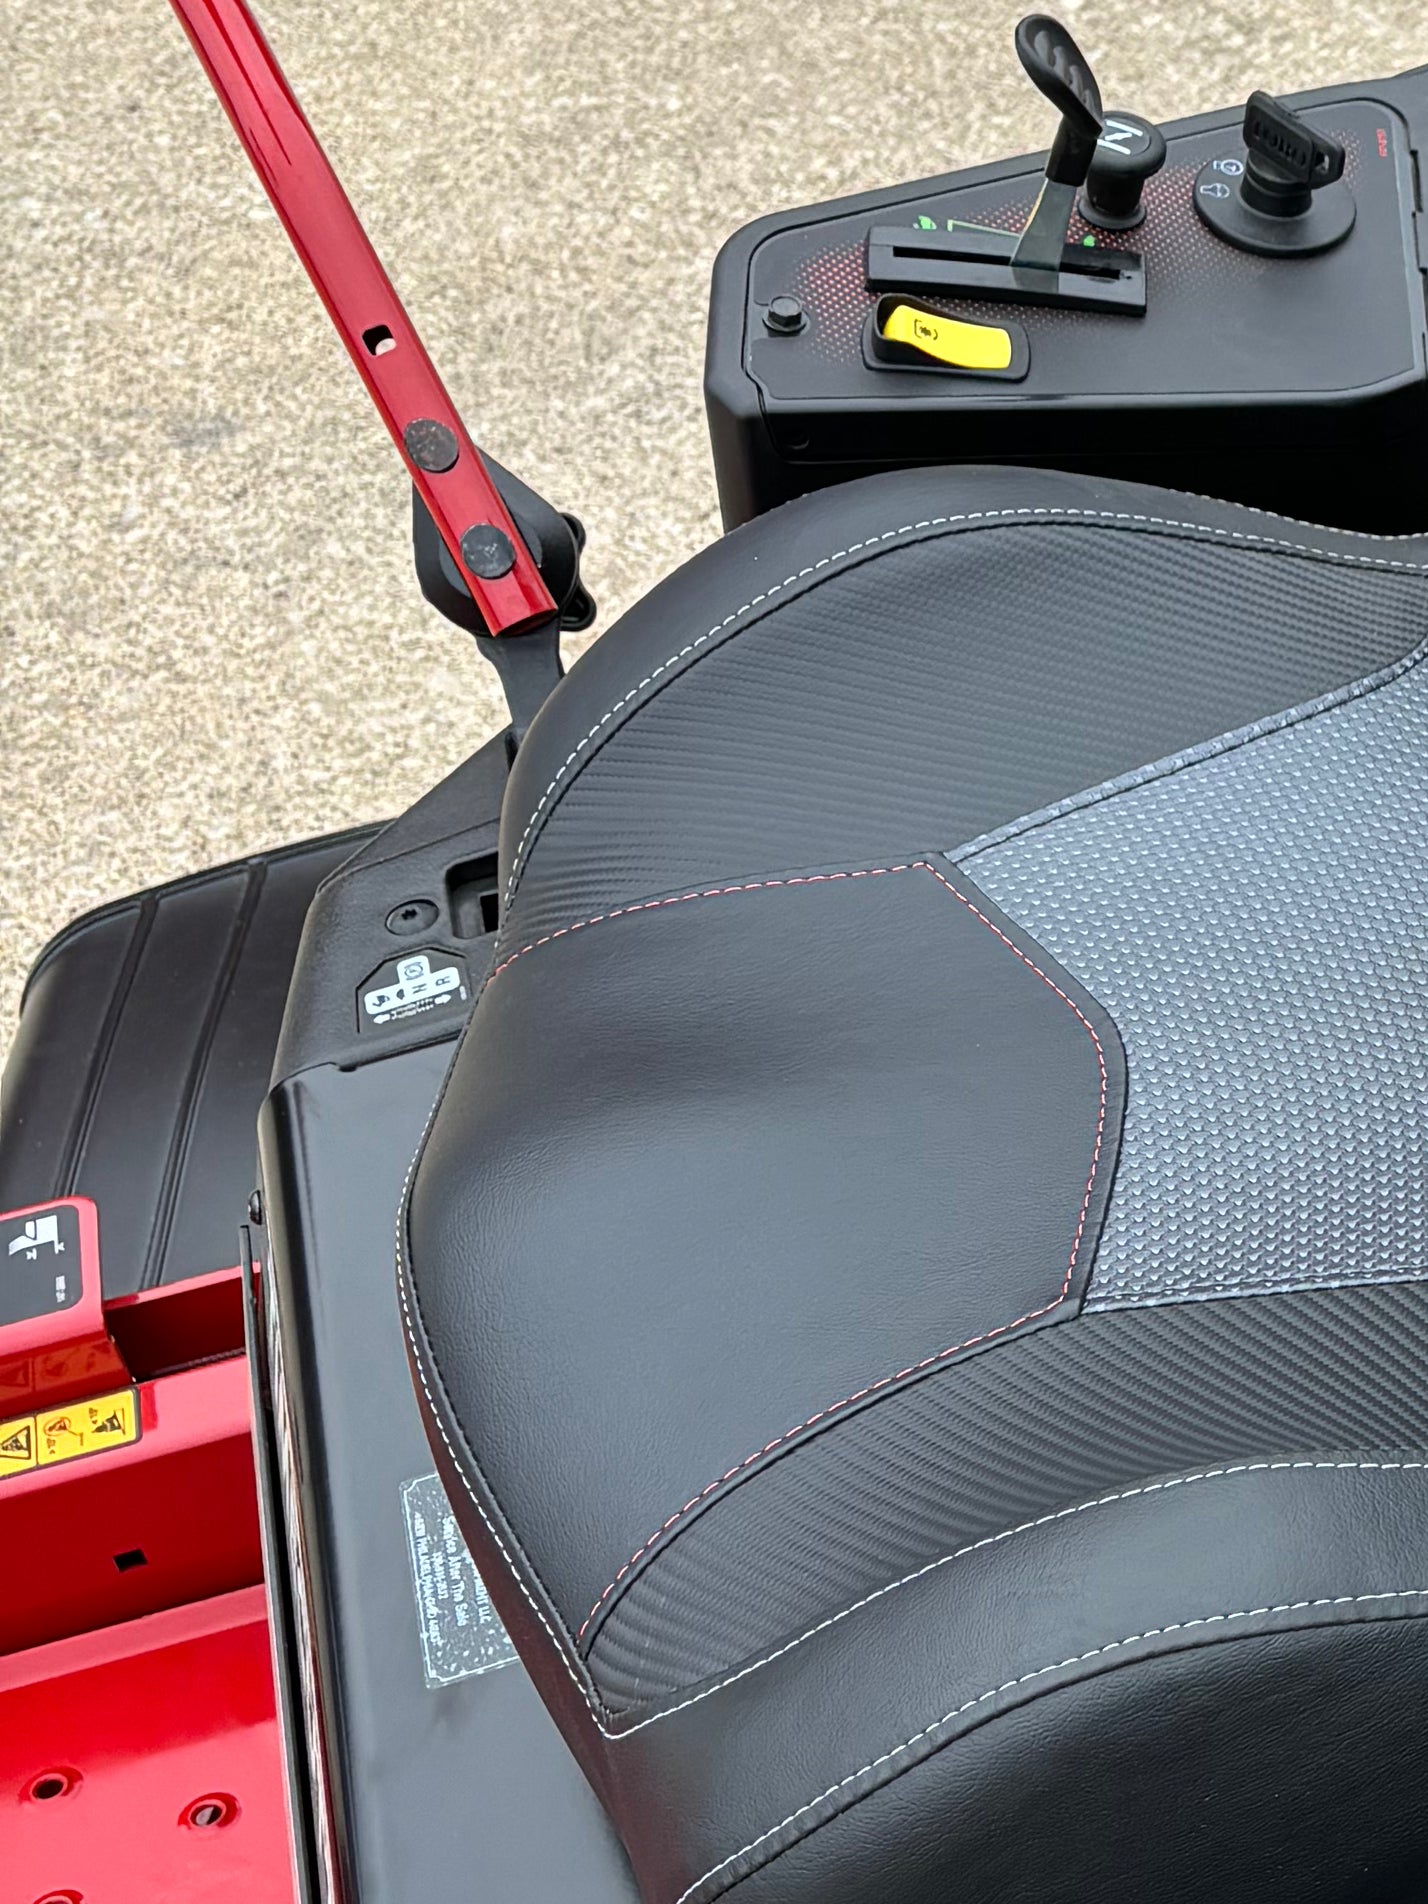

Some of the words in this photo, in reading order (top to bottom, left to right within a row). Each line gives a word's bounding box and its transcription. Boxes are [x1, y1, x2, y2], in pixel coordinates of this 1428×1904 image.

[448, 1556, 461, 1580] After
[452, 1581, 465, 1602] The
[455, 1603, 470, 1626] Sale
